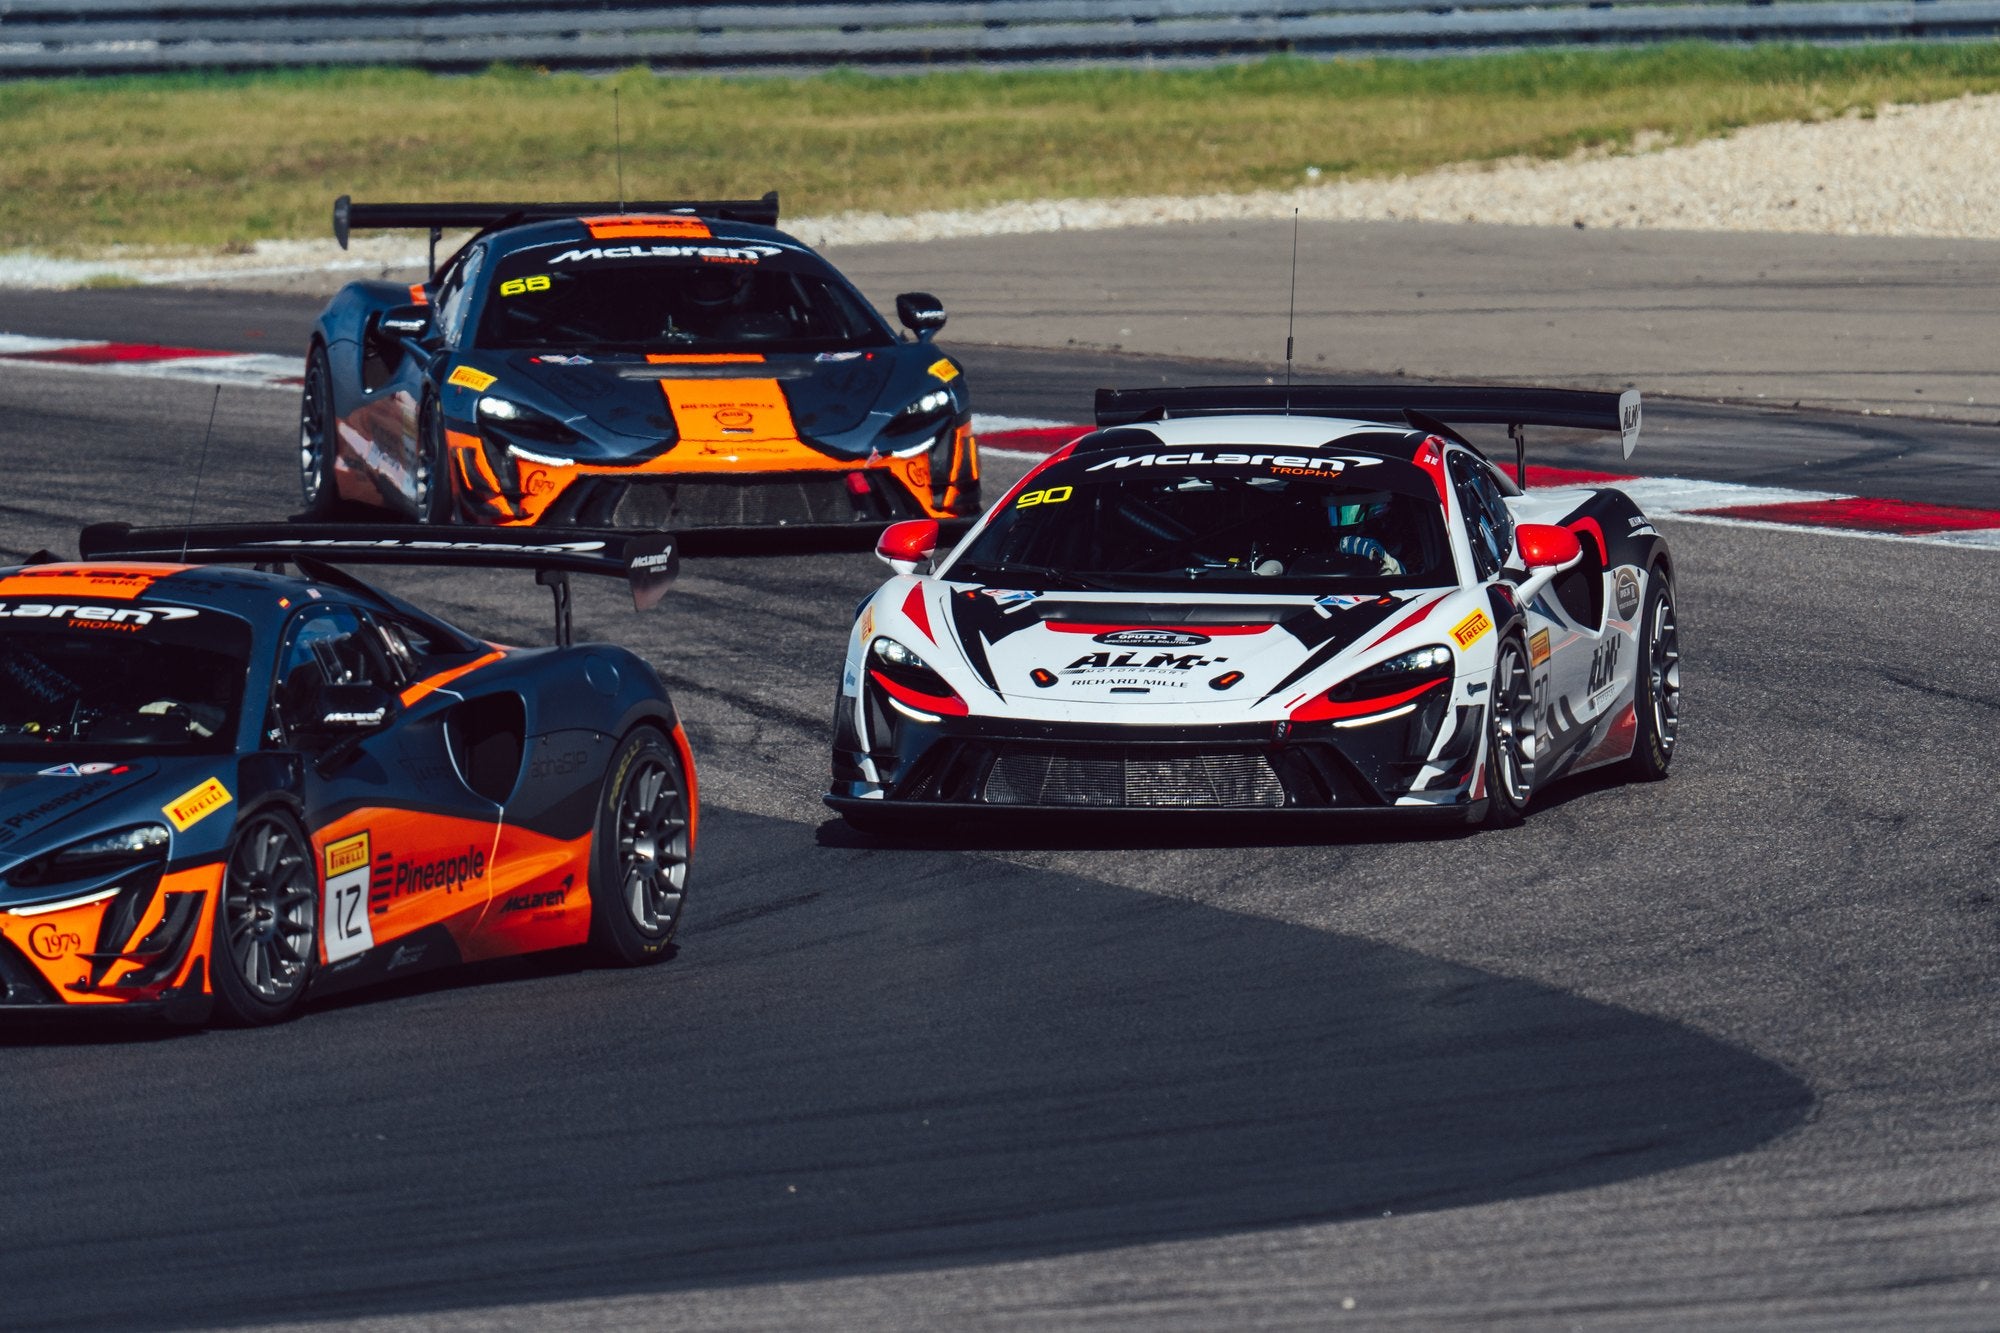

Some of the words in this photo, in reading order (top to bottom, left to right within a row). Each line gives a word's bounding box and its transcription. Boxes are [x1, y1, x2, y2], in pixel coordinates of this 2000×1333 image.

[548, 246, 760, 264] McLaren
[500, 274, 551, 298] 68
[1085, 452, 1346, 473] McLaren
[1270, 466, 1341, 479] TROPHY
[1016, 486, 1074, 509] 90
[68, 618, 144, 633] TROPHY
[1454, 613, 1489, 646] PIRELLI
[1064, 651, 1212, 670] ALM
[1071, 678, 1138, 686] RICHARD
[1143, 678, 1189, 688] MILLE
[173, 785, 223, 822] PIRELLI
[331, 841, 364, 869] PIRELLI
[394, 845, 485, 897] Pineapple
[335, 884, 362, 940] 12
[500, 889, 565, 913] McLaren
